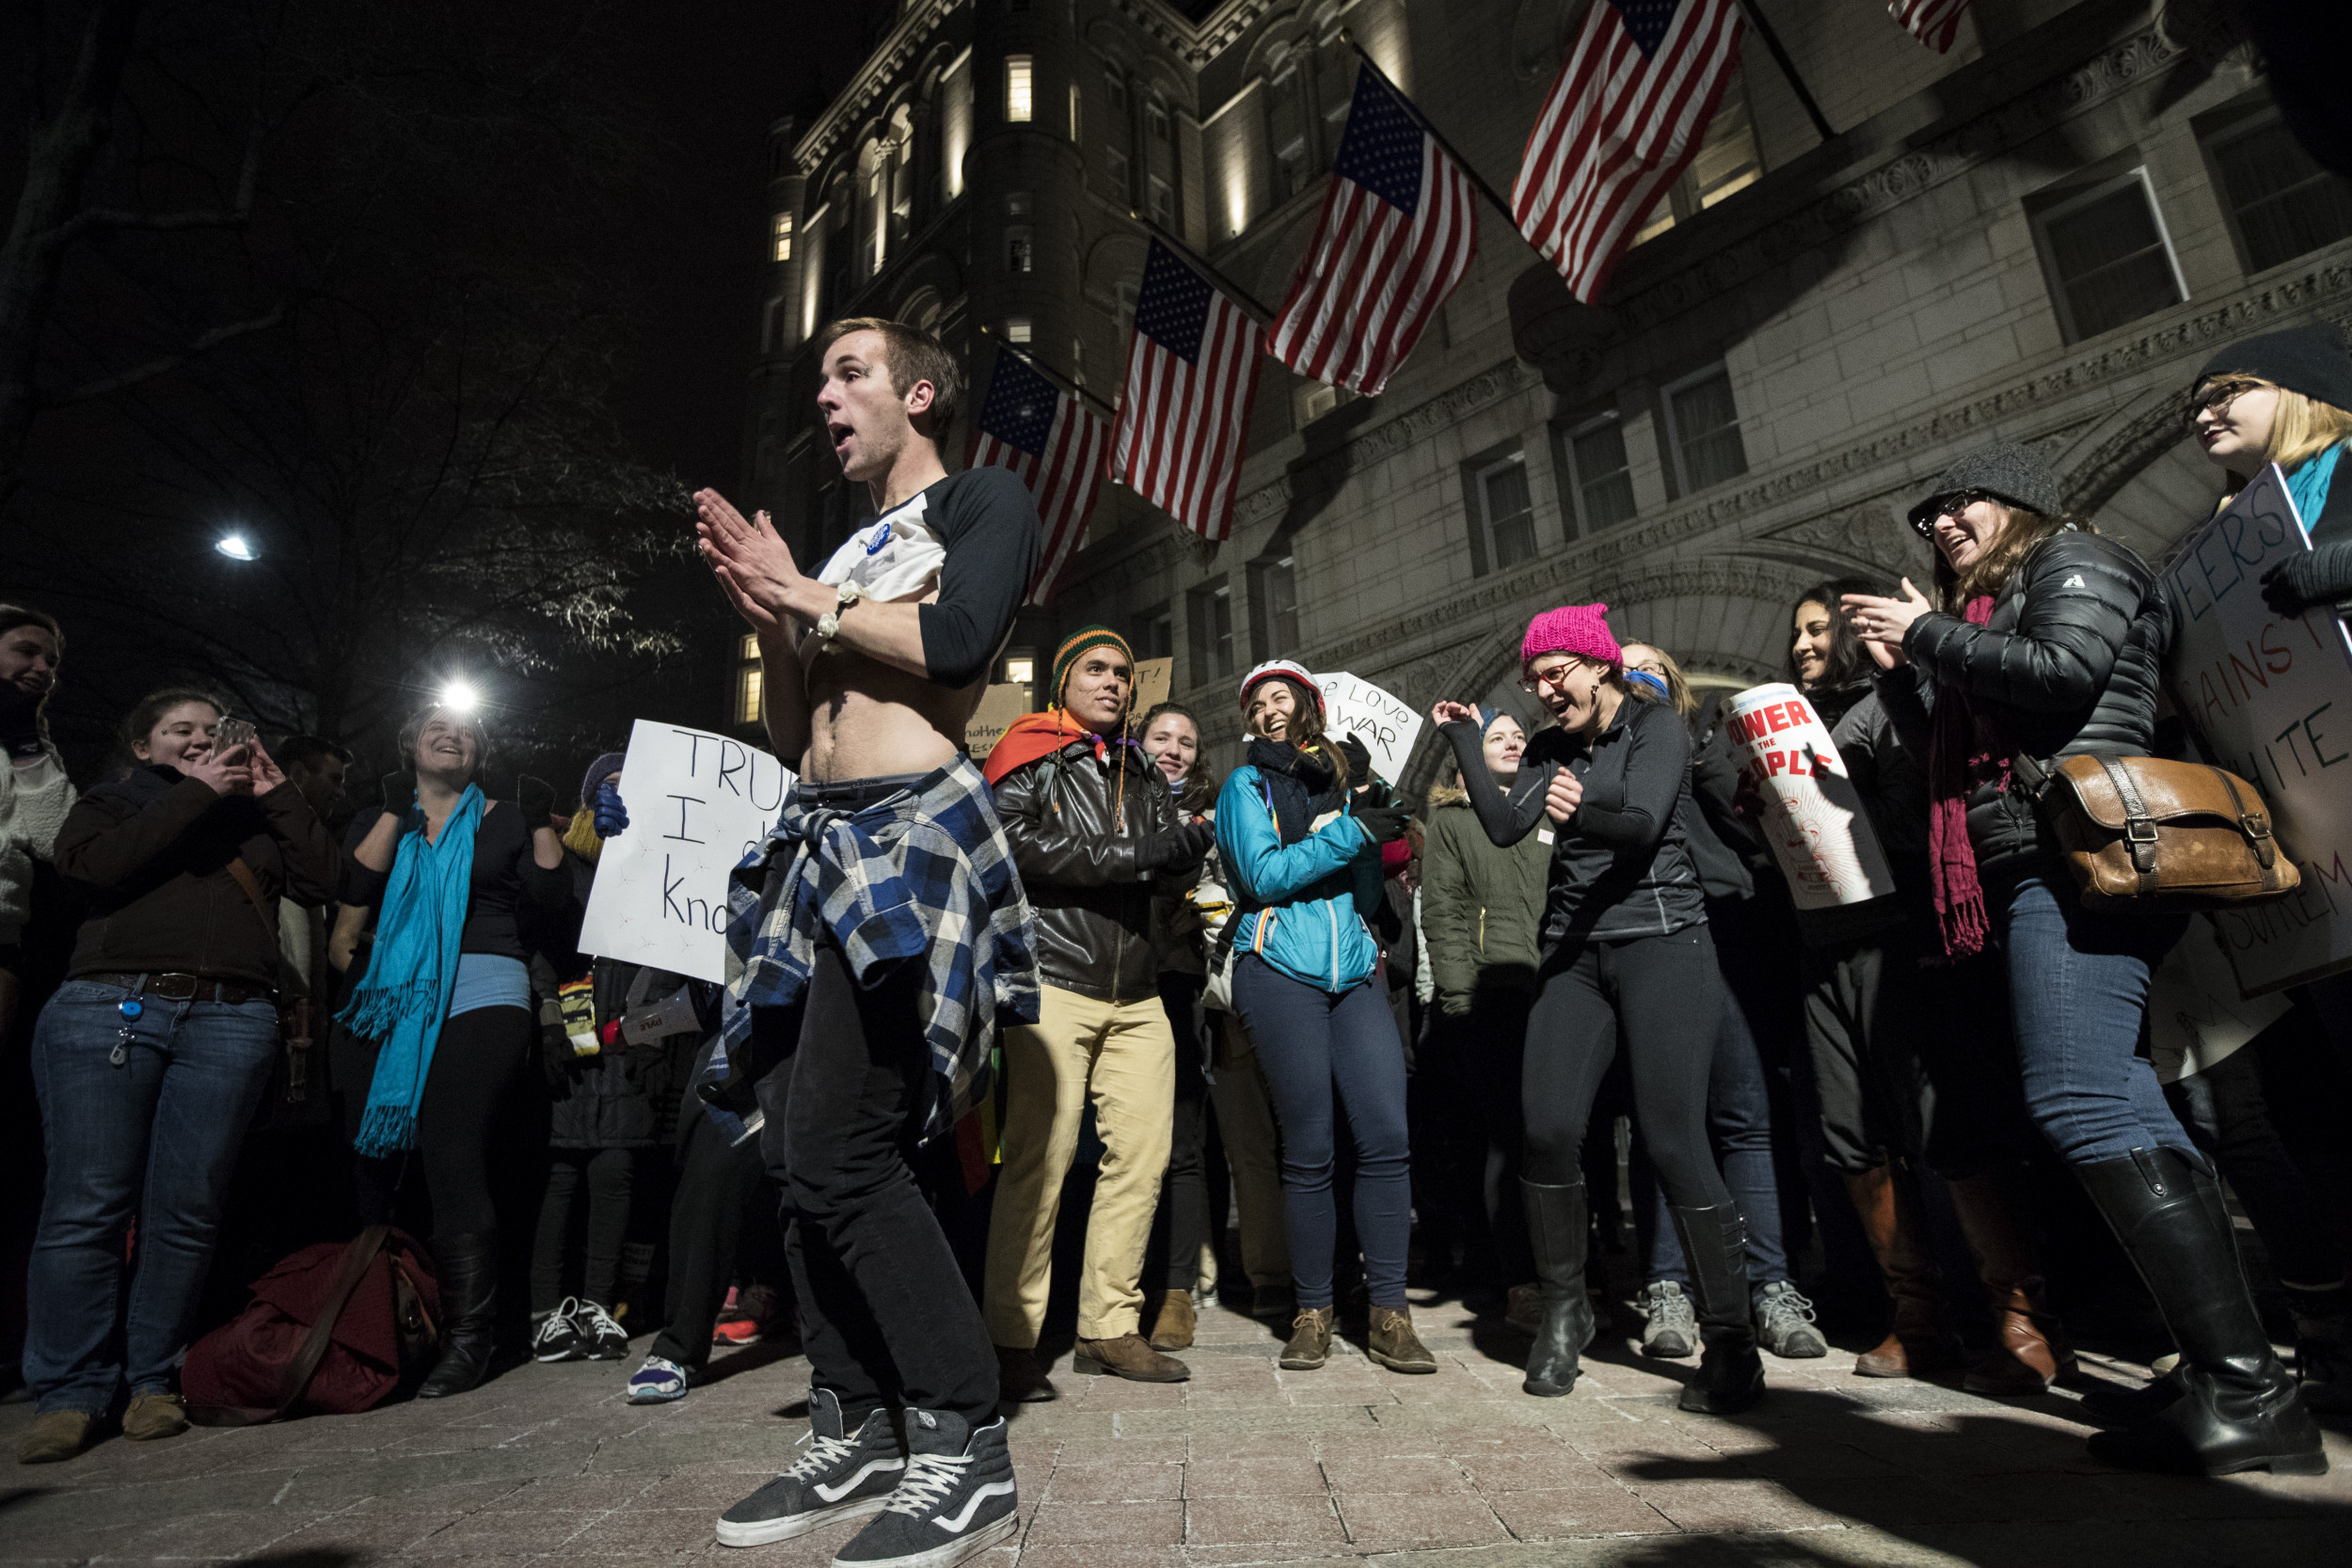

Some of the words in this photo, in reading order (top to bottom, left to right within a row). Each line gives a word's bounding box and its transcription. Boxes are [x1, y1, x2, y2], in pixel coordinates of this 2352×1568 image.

[1337, 705, 1396, 762] WAR
[1757, 737, 1777, 751] THE
[2227, 703, 2350, 799] HITE
[672, 729, 793, 812] TRU
[1747, 751, 1833, 782] OPLE
[662, 795, 707, 846] I
